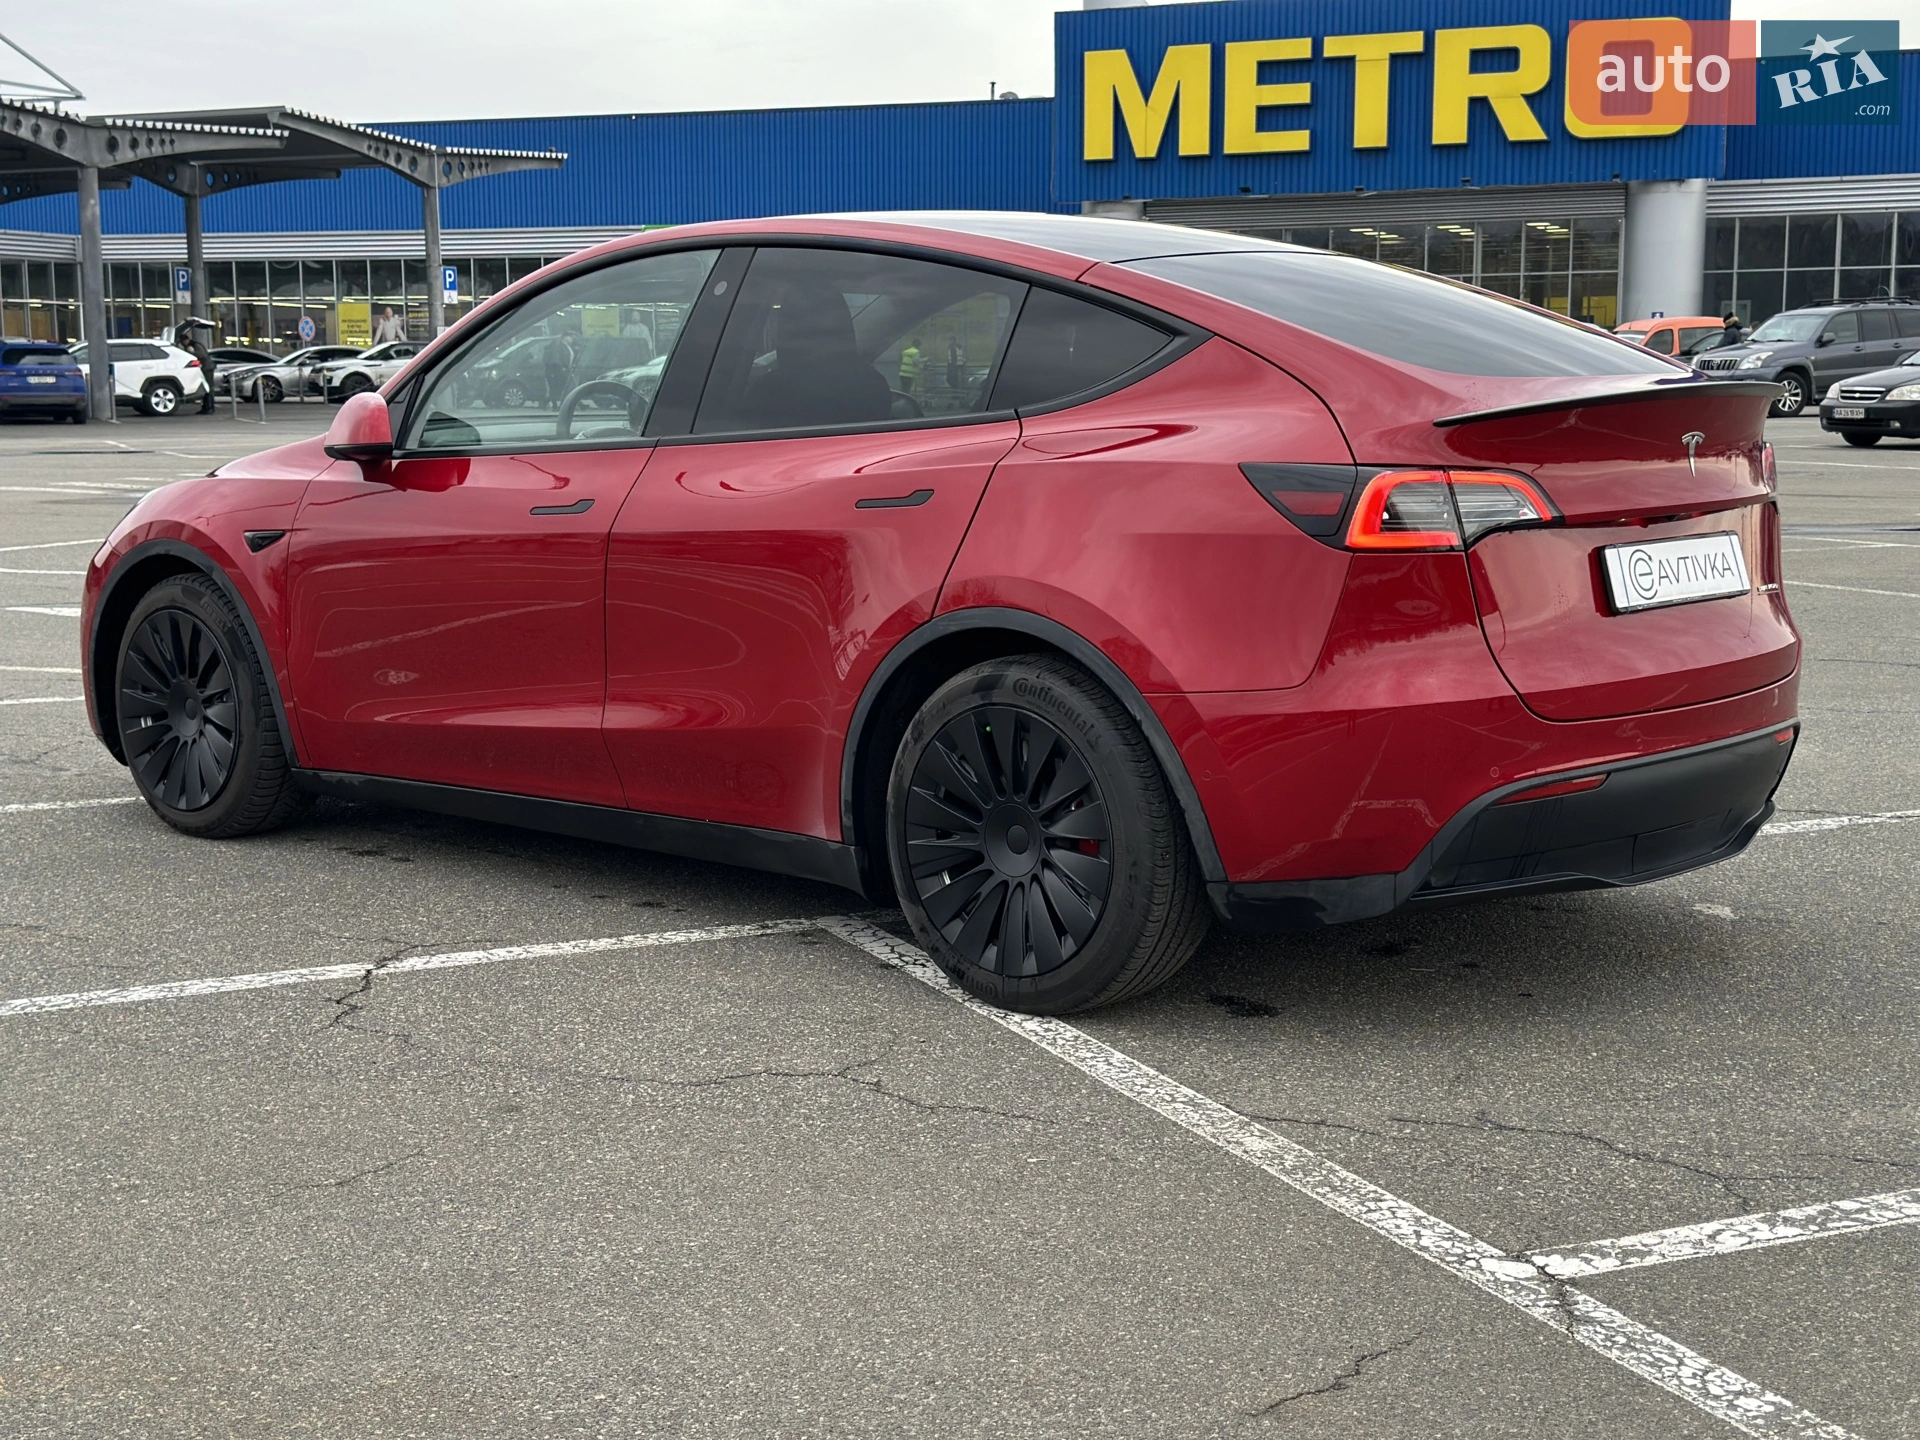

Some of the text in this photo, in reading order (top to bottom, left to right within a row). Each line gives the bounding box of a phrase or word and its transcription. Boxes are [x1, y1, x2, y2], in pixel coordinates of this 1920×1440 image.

[1084, 17, 1693, 161] METRO
[179, 270, 188, 289] P
[445, 269, 455, 289] P
[1658, 551, 1735, 586] AVTIVKA
[1012, 677, 1096, 737] Continental
